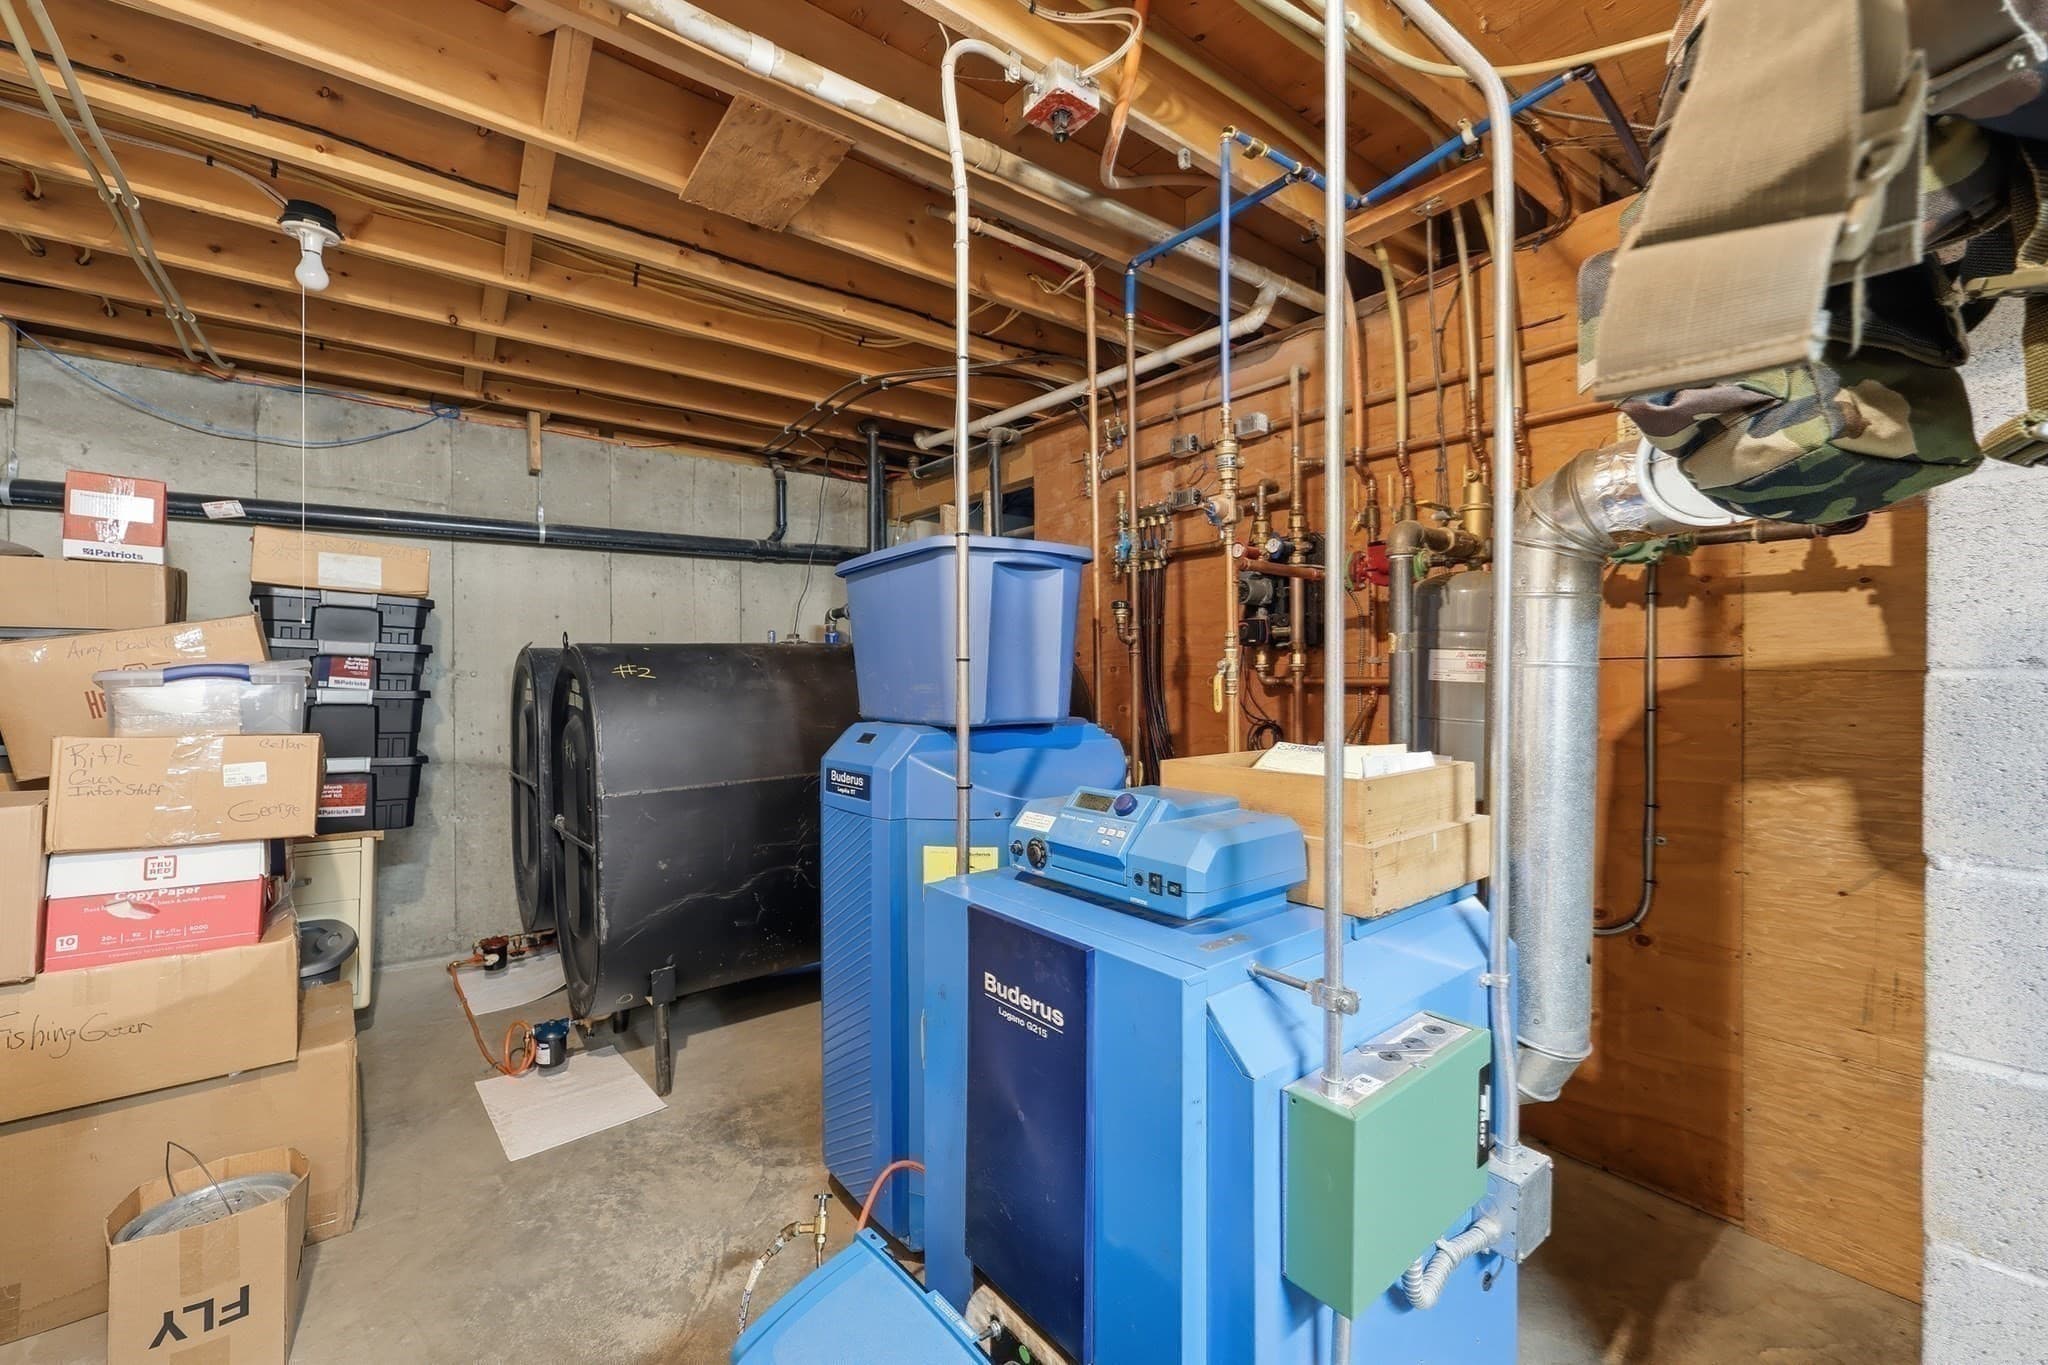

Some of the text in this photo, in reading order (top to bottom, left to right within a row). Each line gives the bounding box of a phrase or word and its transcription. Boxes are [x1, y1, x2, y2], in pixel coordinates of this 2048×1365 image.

[611, 664, 657, 679] #2
[65, 743, 141, 768] Rifle
[68, 769, 126, 785] Gun
[830, 769, 864, 787] Buderus
[227, 799, 301, 823] George
[150, 861, 172, 869] TRU
[114, 886, 201, 902] Copy Paper
[58, 937, 75, 947] 10
[984, 971, 1065, 1027] Buderus
[998, 1006, 1048, 1039] Logano G215
[148, 1284, 250, 1350] FLY
